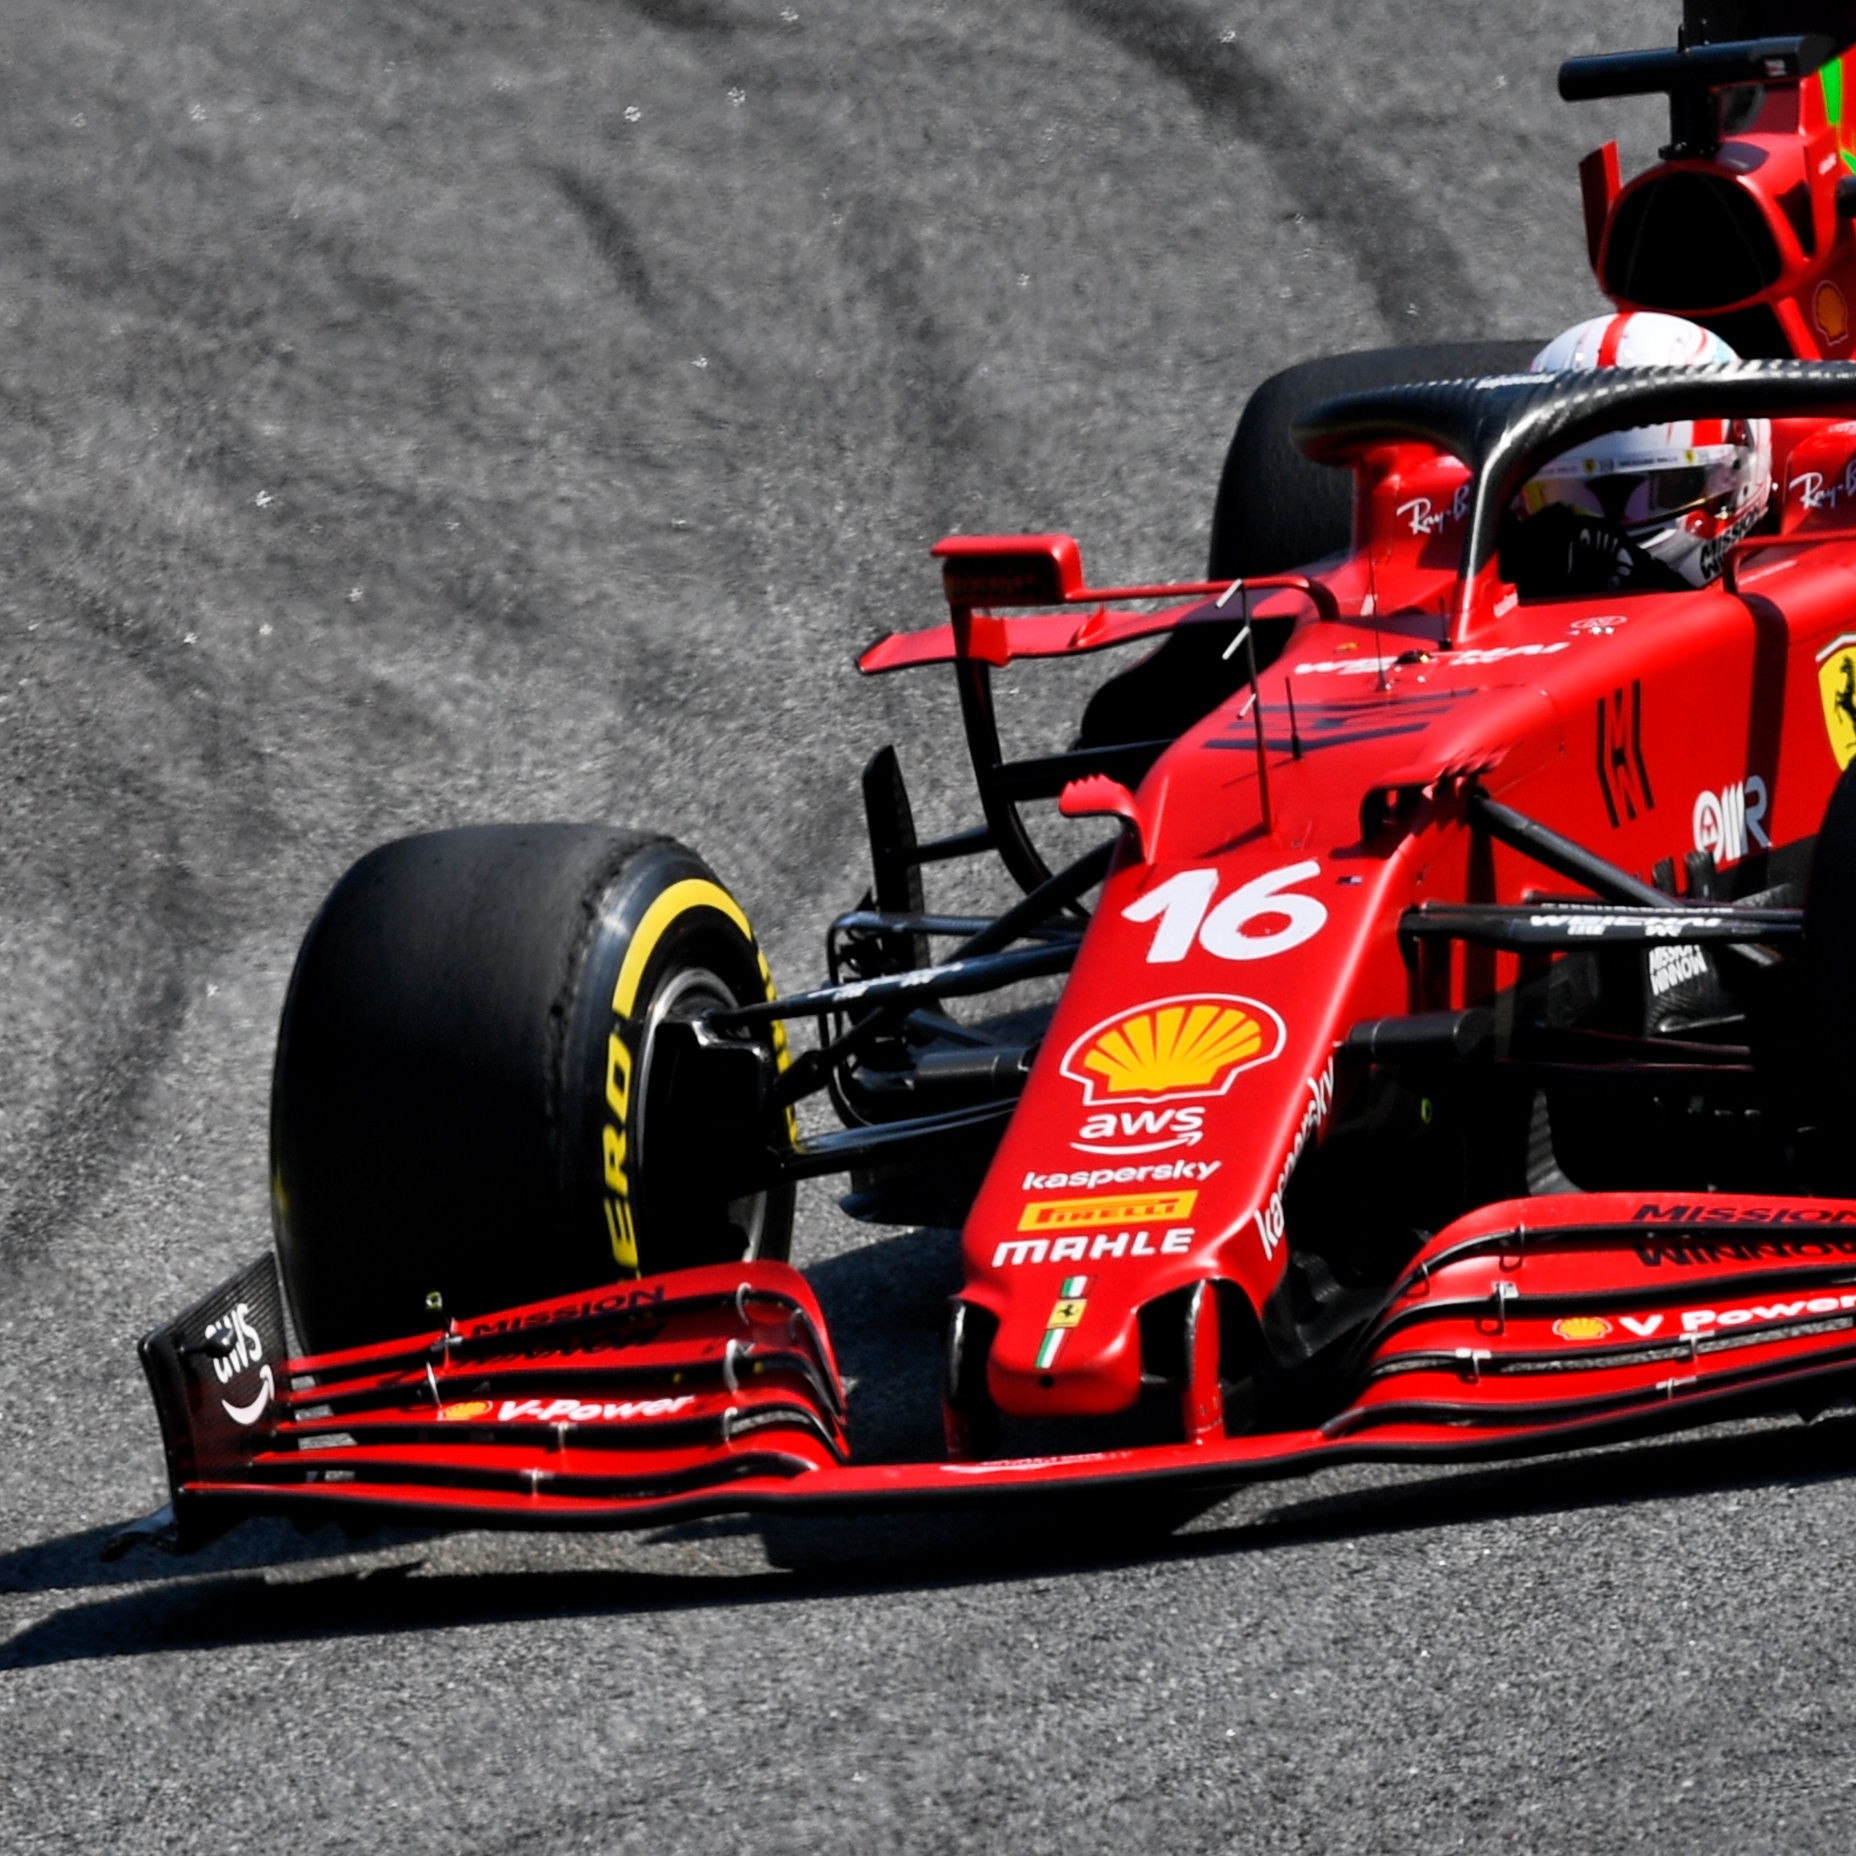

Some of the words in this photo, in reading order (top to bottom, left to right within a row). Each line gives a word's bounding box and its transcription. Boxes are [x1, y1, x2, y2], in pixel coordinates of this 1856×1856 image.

[1396, 484, 1470, 535] Ray-B
[1120, 859, 1328, 964] 16
[1079, 1106, 1205, 1139] aws
[603, 1032, 641, 1274] ERO
[1022, 1158, 1222, 1191] kaspersky
[1034, 1195, 1181, 1224] PIRELLI
[992, 1227, 1196, 1269] MAHLE
[497, 1395, 697, 1421] V-Power
